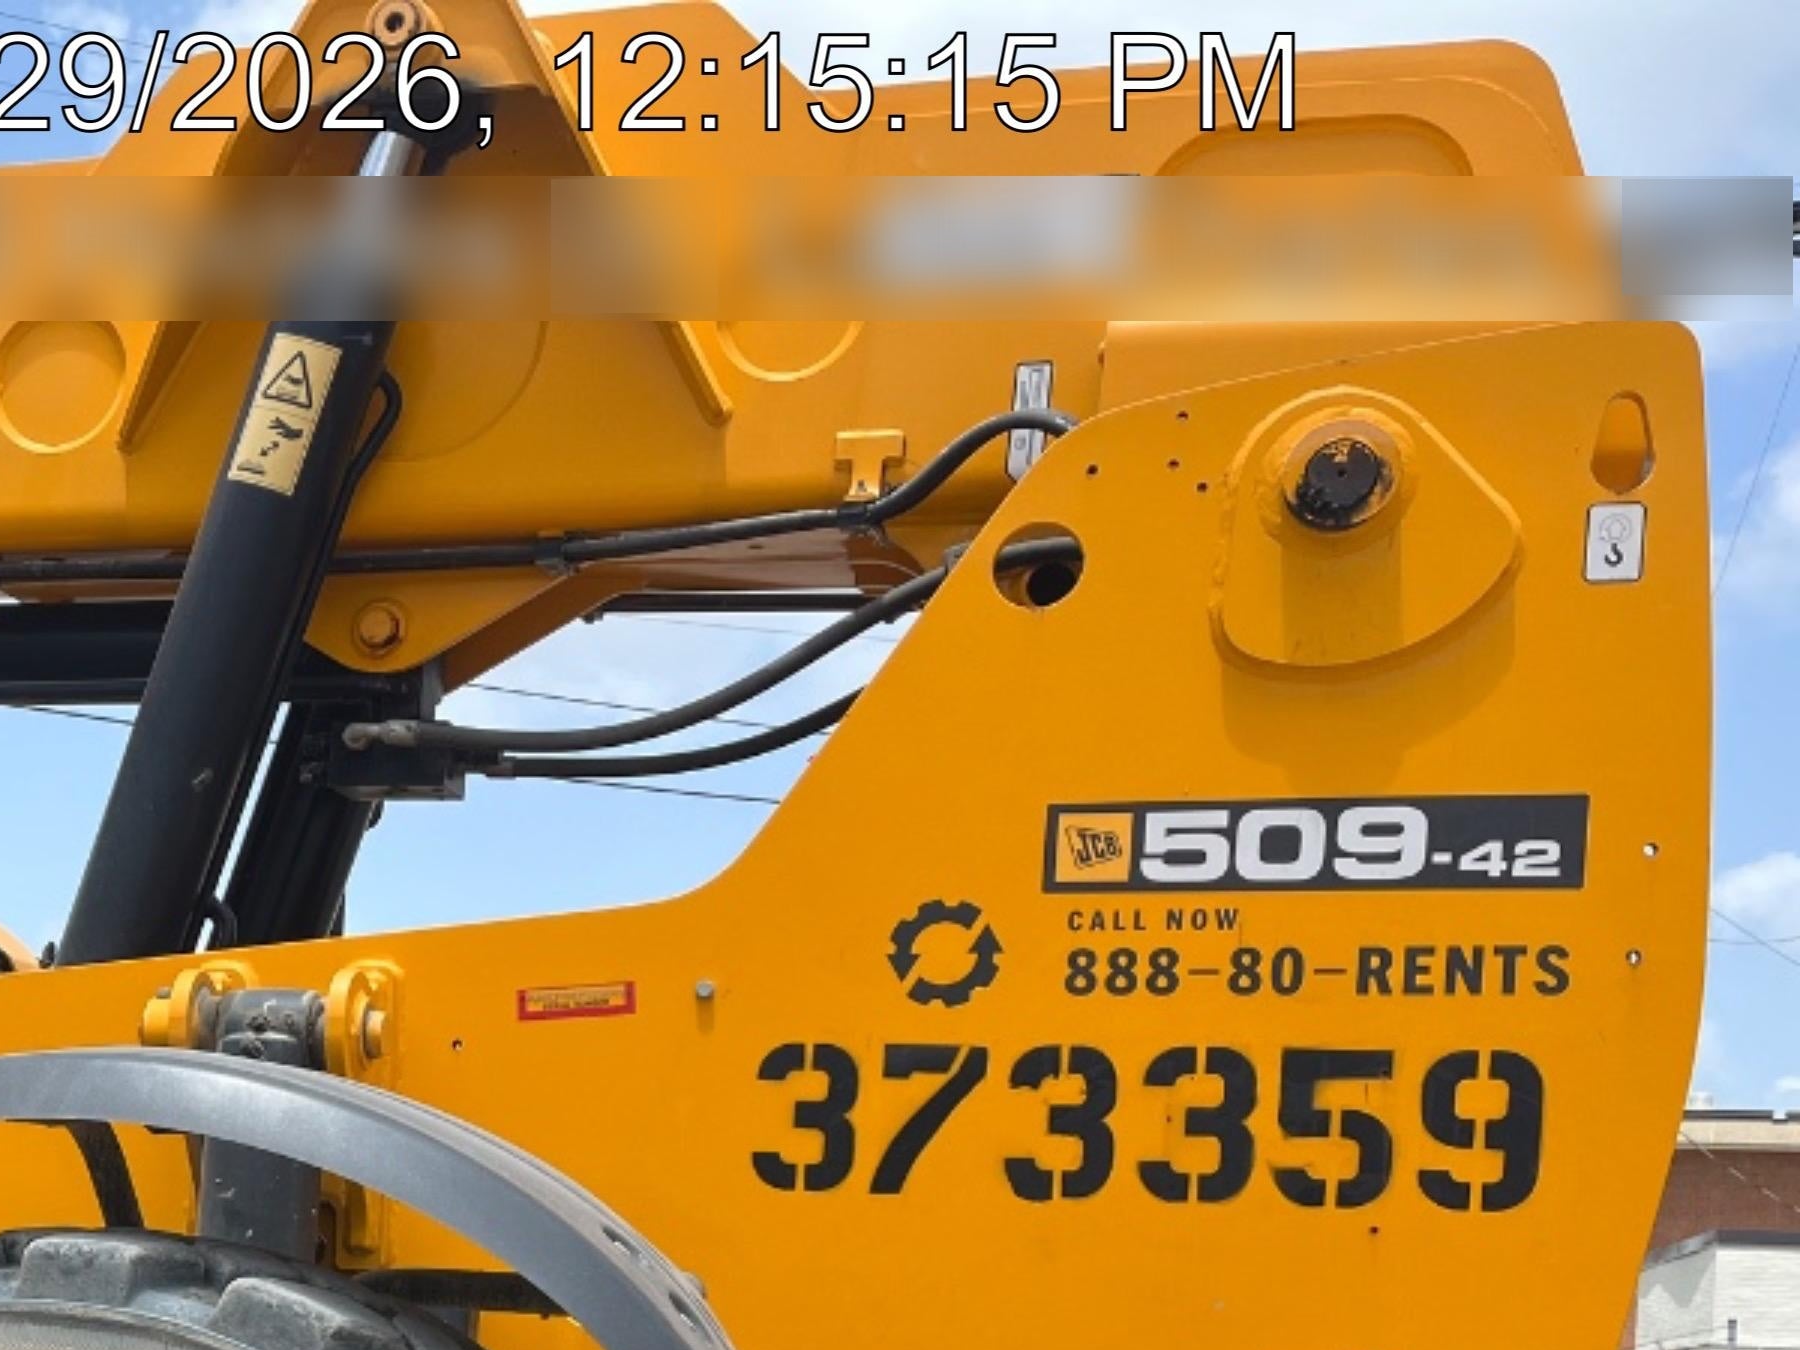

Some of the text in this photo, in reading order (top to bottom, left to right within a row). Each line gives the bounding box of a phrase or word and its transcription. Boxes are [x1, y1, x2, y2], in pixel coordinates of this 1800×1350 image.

[1139, 806, 1562, 883] 509-42
[1067, 908, 1240, 932] CALL NOW
[1064, 945, 1571, 997] 888-80-RENTS
[751, 1042, 1544, 1213] 373359
